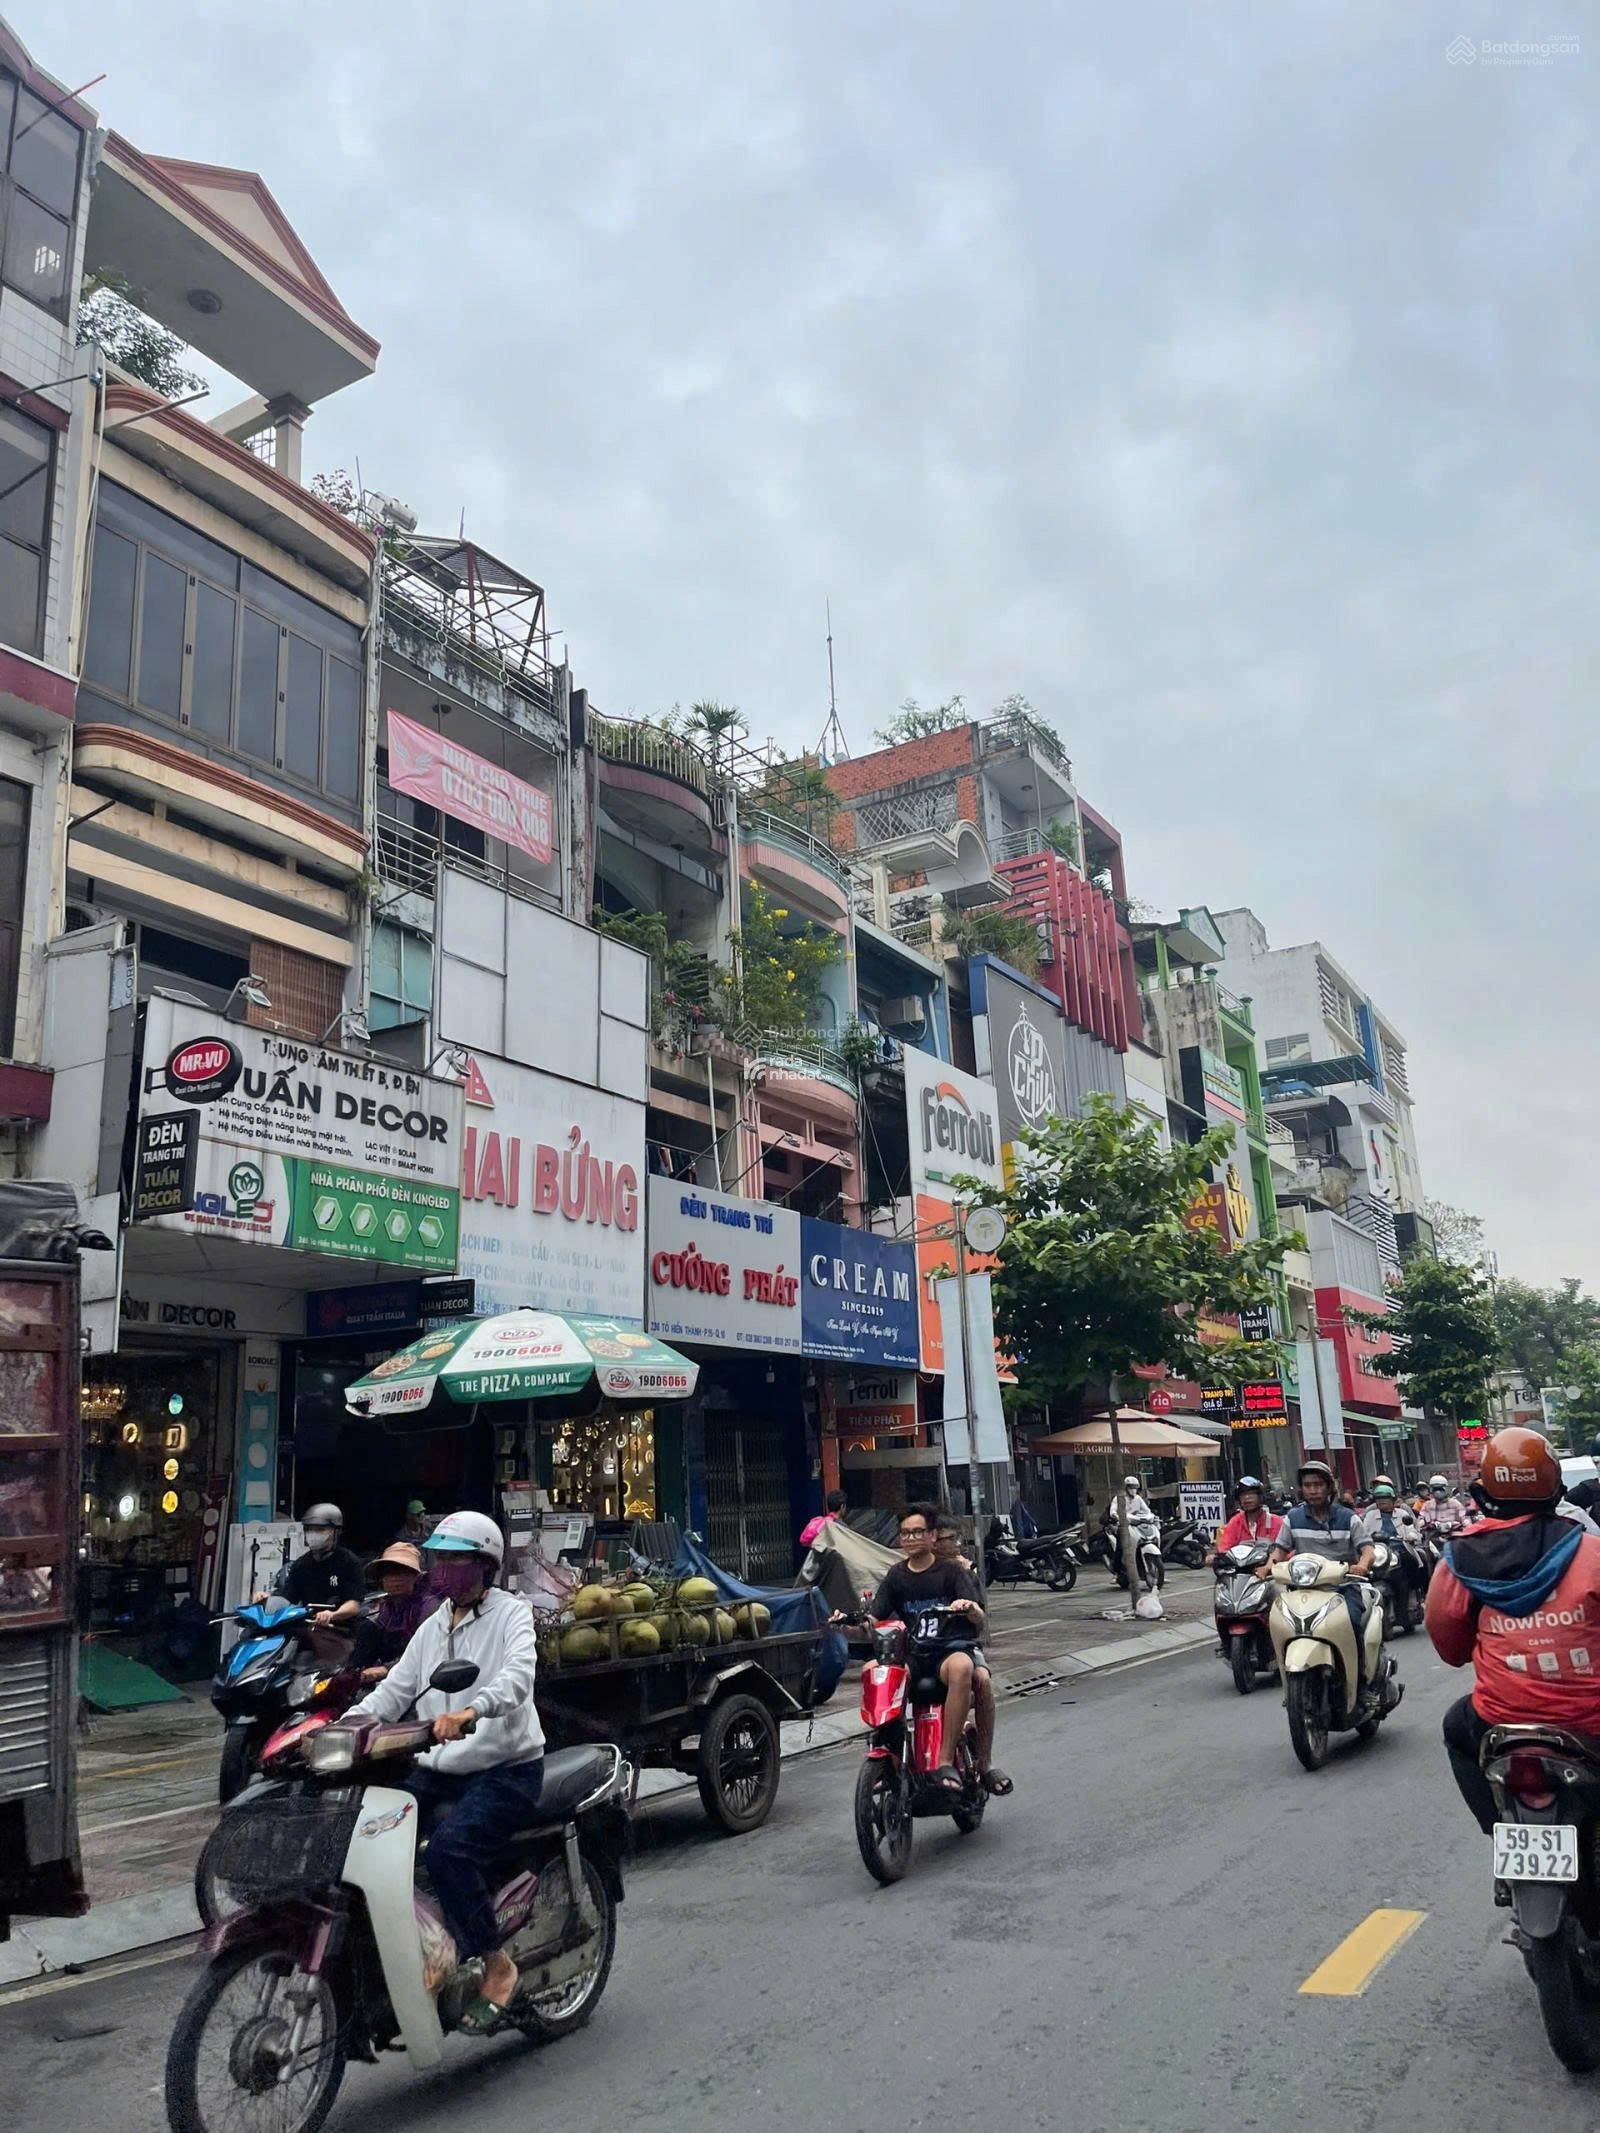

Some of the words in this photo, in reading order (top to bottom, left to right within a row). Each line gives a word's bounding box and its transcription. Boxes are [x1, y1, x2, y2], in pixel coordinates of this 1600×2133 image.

[263, 1038, 308, 1064] TUNG
[312, 1050, 339, 1073] ÂM
[343, 1060, 375, 1083] THẾT
[393, 1074, 420, 1096] ĐỆN
[231, 1097, 252, 1110] Cung
[238, 1064, 321, 1114] UẤN
[335, 1090, 448, 1144] DECOR
[219, 1108, 230, 1118] Hệ
[232, 1109, 254, 1124] thống
[256, 1116, 273, 1127] Điện
[920, 1086, 995, 1167] Ferroli
[149, 1120, 184, 1147] ĐÈN
[218, 1121, 229, 1132] Hệ
[231, 1123, 254, 1138] thống
[142, 1148, 170, 1164] TRANG
[170, 1143, 186, 1160] TRÍ
[533, 1124, 639, 1232] BỬNG
[138, 1188, 182, 1209] DECOR
[310, 1170, 333, 1188] NHÀ
[336, 1175, 363, 1193] PHÂN
[366, 1177, 390, 1199] PHỐI
[391, 1184, 410, 1203] ĐÈN
[412, 1191, 450, 1210] KINGLED
[680, 1192, 707, 1219] ĐÈN
[711, 1203, 751, 1232] TRANG
[754, 1213, 773, 1235] TRÍ
[743, 1263, 799, 1308] PHÁT
[811, 1254, 911, 1302] CREAM
[443, 1298, 469, 1309] DECOR
[163, 1303, 237, 1329] DECOR
[1242, 1318, 1269, 1329] TRANG
[1251, 1328, 1263, 1340] TRÍ
[473, 1343, 564, 1359] 19006066
[460, 1380, 478, 1392] THE
[480, 1373, 521, 1394] PIZZA
[524, 1372, 571, 1387] COMPANY
[639, 1375, 687, 1387] 19006066
[381, 1386, 424, 1403] 19006066
[1203, 1390, 1224, 1399] TRANG
[1231, 1420, 1250, 1430] HUY
[1253, 1417, 1287, 1428] HOÀNG
[1086, 1445, 1131, 1454] AGRIBK
[1181, 1484, 1221, 1492] PHARMACY
[1512, 1472, 1537, 1483] Food
[1490, 1604, 1585, 1634] NowFood
[1506, 1828, 1562, 1852] 59-S1
[1499, 1852, 1573, 1877] 739.22
